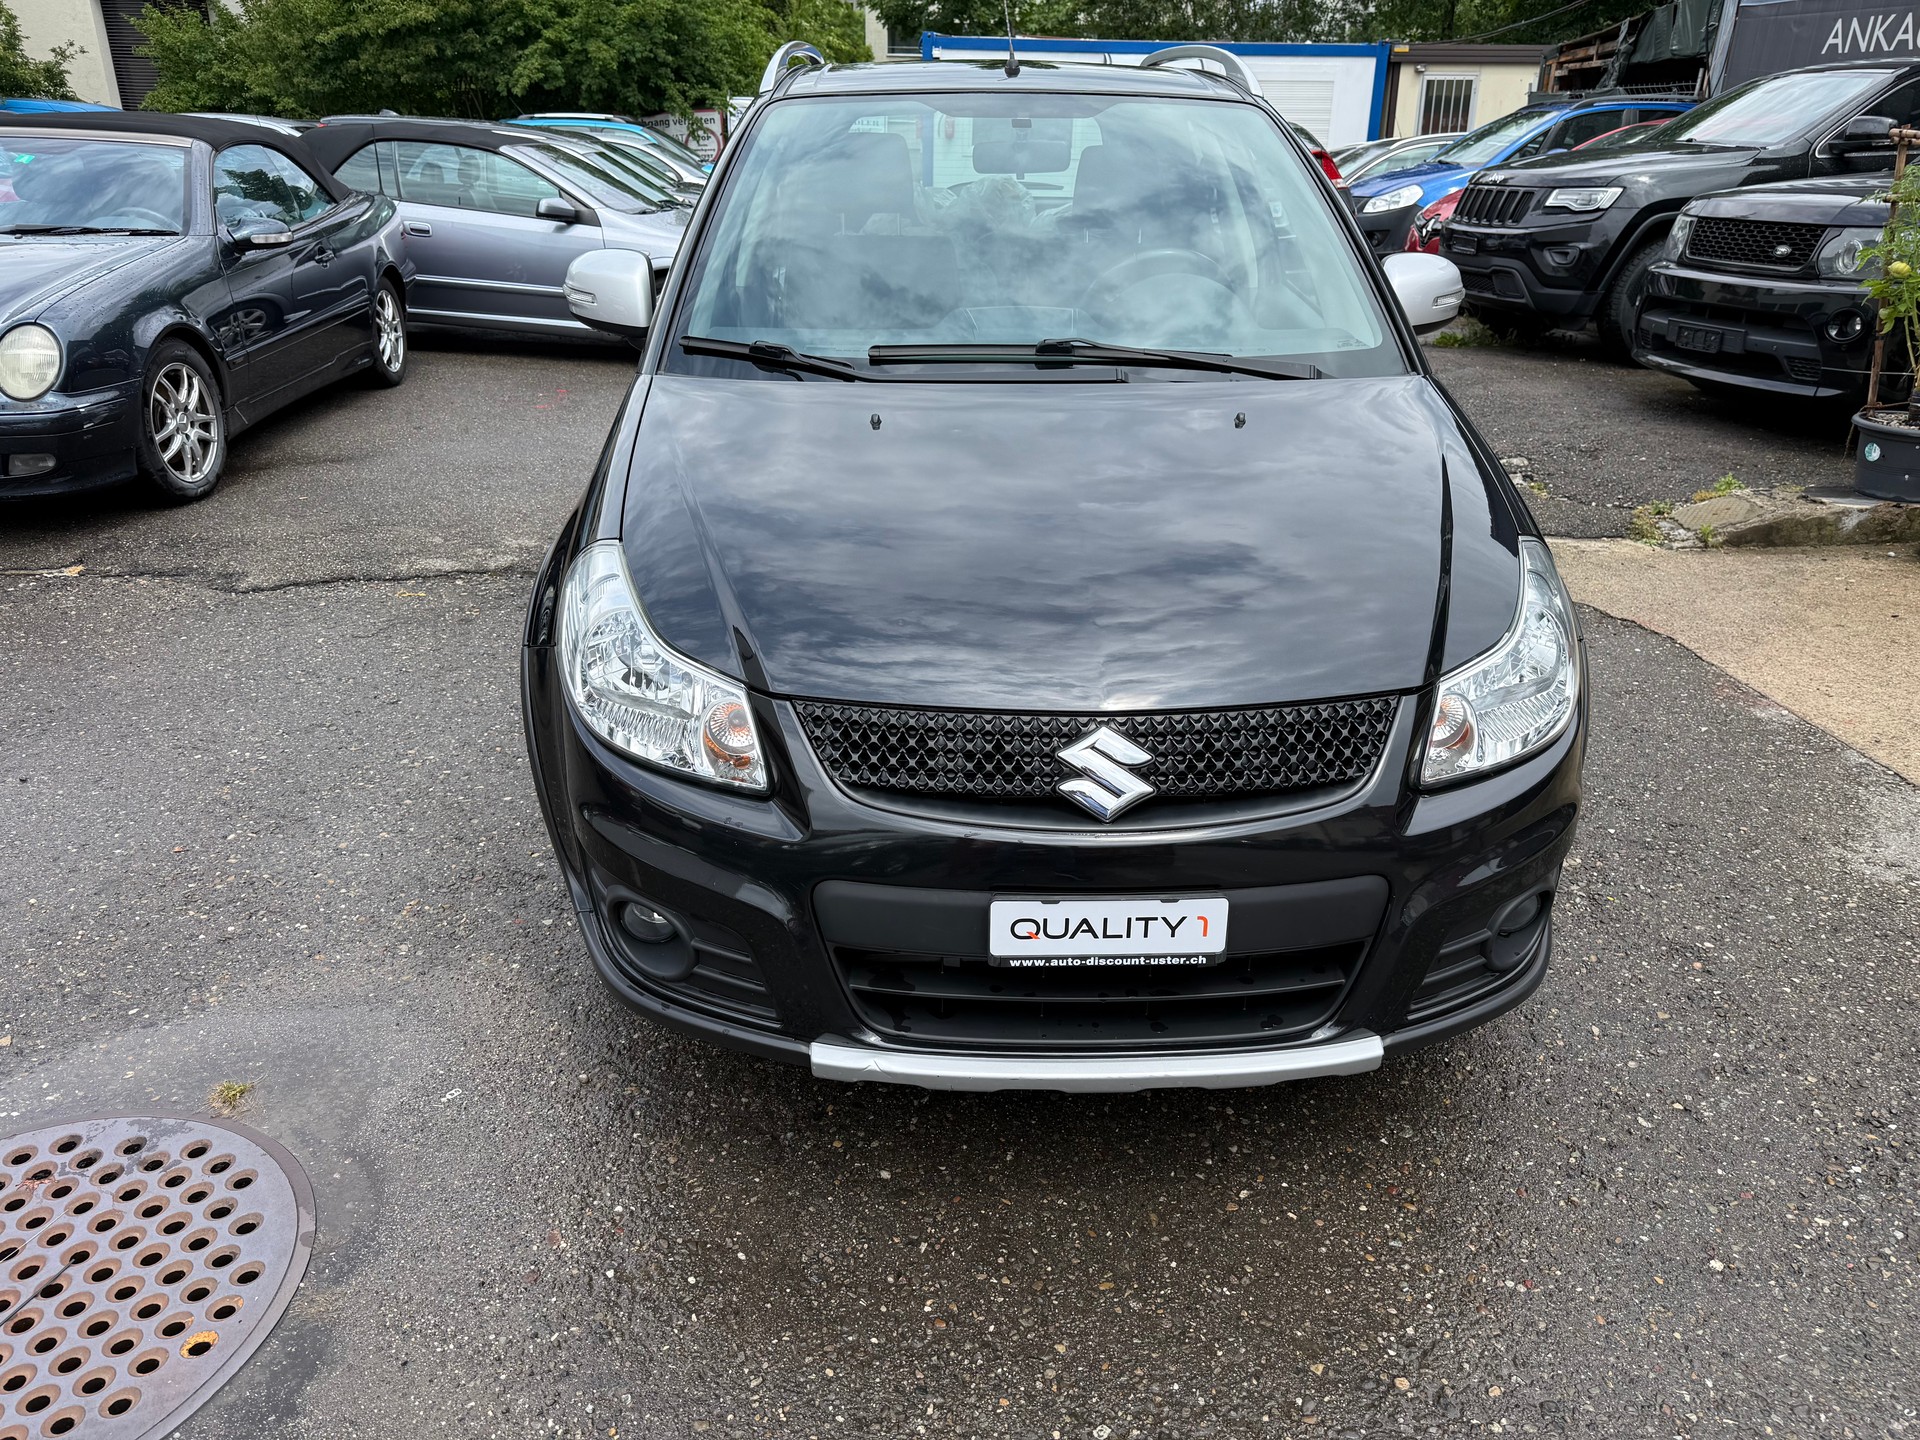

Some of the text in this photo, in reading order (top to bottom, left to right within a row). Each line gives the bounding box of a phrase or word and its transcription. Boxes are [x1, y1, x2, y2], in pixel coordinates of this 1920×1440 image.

[1820, 11, 1920, 54] ANKA
[1010, 915, 1209, 940] QUALITY 1
[1009, 955, 1207, 967] www.auto-discount-uster.ch
